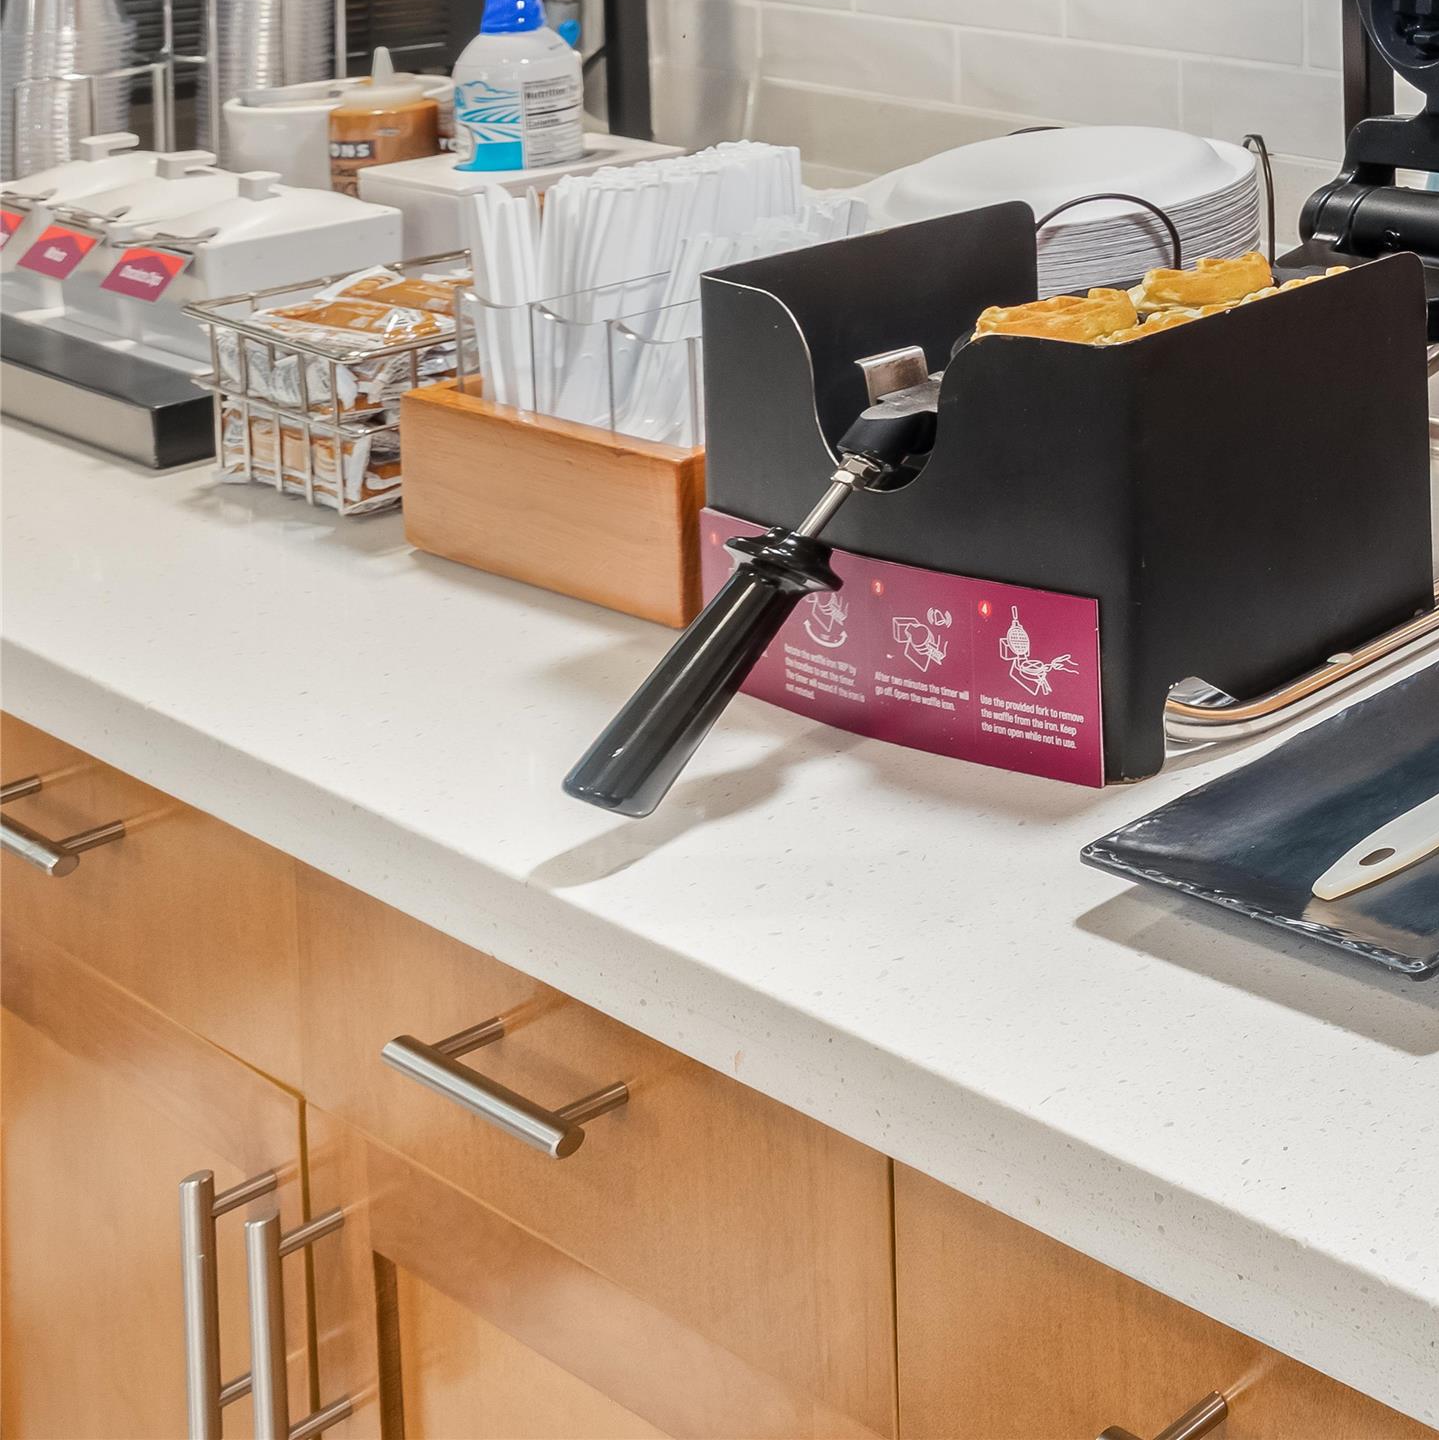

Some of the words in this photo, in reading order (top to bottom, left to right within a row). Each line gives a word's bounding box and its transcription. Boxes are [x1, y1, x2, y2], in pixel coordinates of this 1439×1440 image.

[980, 694, 992, 705] Use
[993, 697, 1004, 707] the
[1005, 701, 1034, 713] provided
[1035, 704, 1049, 716] fork
[1050, 709, 1058, 718] to
[1058, 711, 1084, 723] remove
